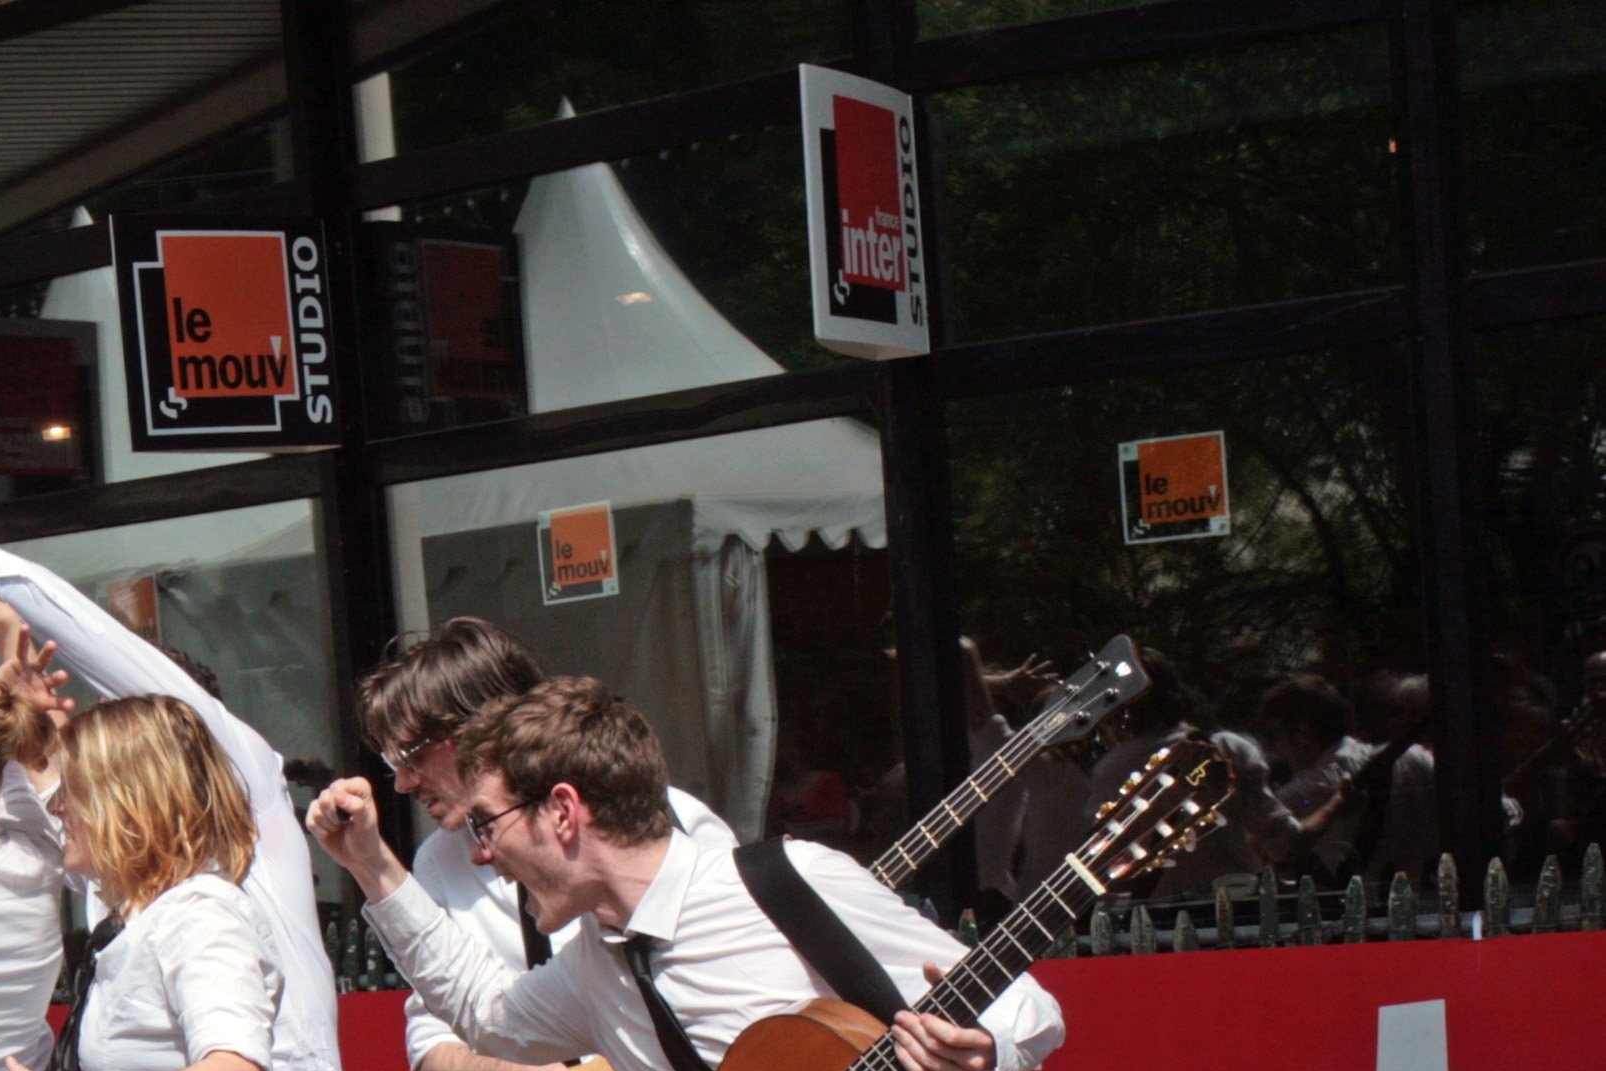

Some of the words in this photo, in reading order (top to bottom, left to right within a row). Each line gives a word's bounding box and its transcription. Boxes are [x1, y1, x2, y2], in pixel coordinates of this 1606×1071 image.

[874, 206, 900, 231] france
[899, 116, 924, 326] STUDIO
[841, 208, 903, 283] inter
[172, 297, 211, 344] le
[293, 236, 333, 425] STUDIO
[1144, 473, 1169, 497] le
[555, 540, 573, 560] le
